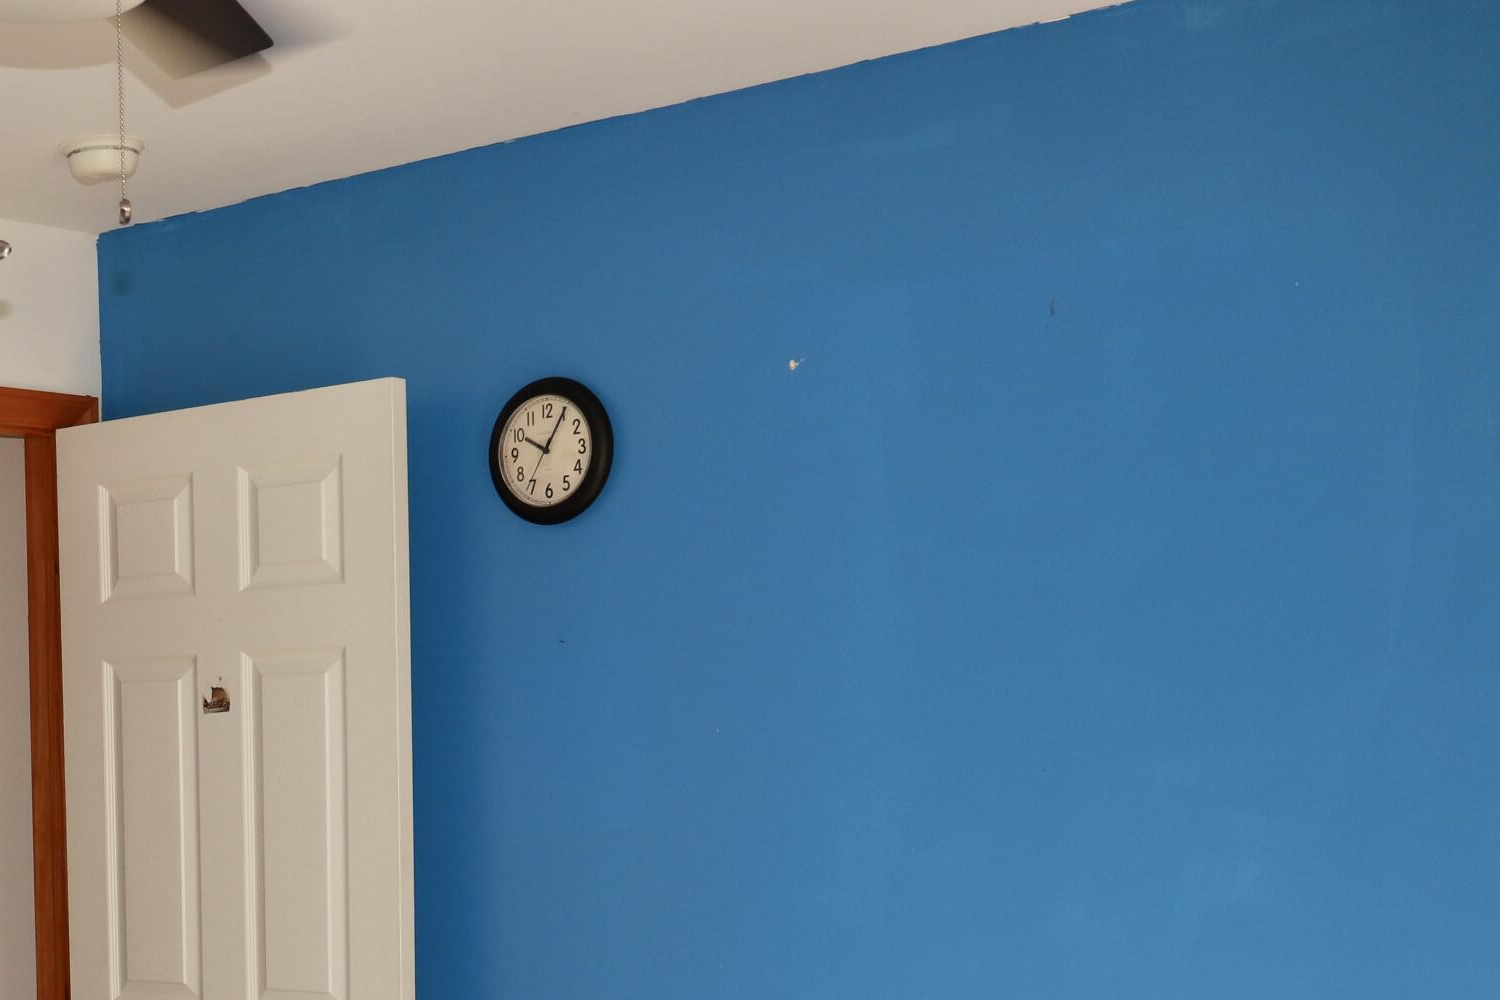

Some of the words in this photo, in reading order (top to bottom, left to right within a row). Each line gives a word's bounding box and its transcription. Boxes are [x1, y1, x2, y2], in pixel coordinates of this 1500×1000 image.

[526, 411, 535, 427] 11
[541, 403, 553, 419] 12
[513, 427, 525, 443] 10
[572, 419, 581, 435] 2
[578, 438, 587, 454] 3
[511, 447, 519, 463] 9
[516, 466, 525, 482] 8
[573, 459, 582, 474] 4
[528, 479, 536, 495] 7
[545, 483, 553, 498] 6
[562, 475, 570, 491] 5
